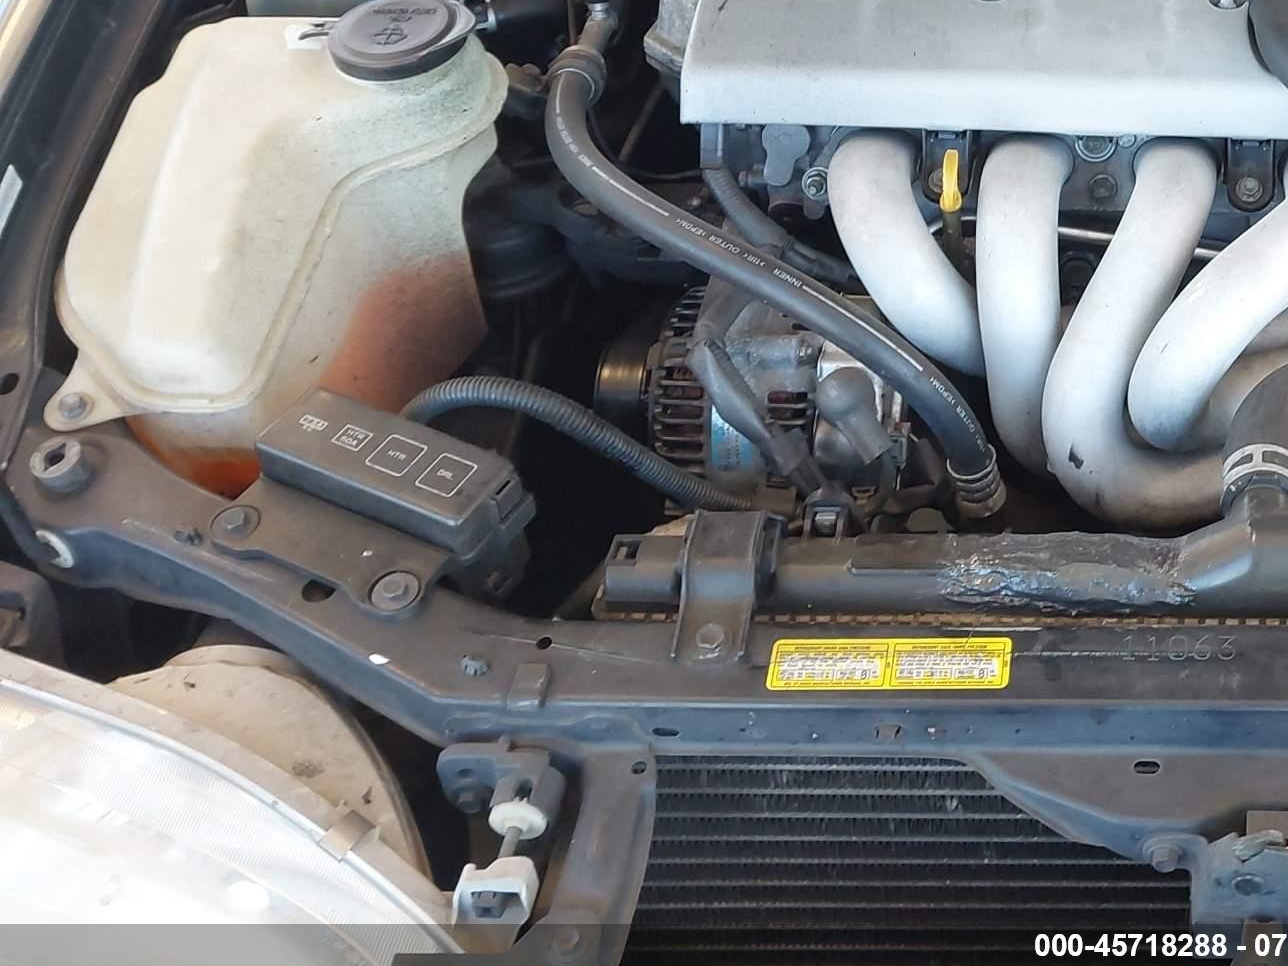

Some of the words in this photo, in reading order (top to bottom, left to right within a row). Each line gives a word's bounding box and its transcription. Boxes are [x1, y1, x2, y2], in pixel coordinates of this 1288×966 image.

[708, 235, 741, 254] OUTER
[773, 268, 802, 288] INNER
[956, 405, 976, 433] OUTER
[386, 449, 407, 461] HTR
